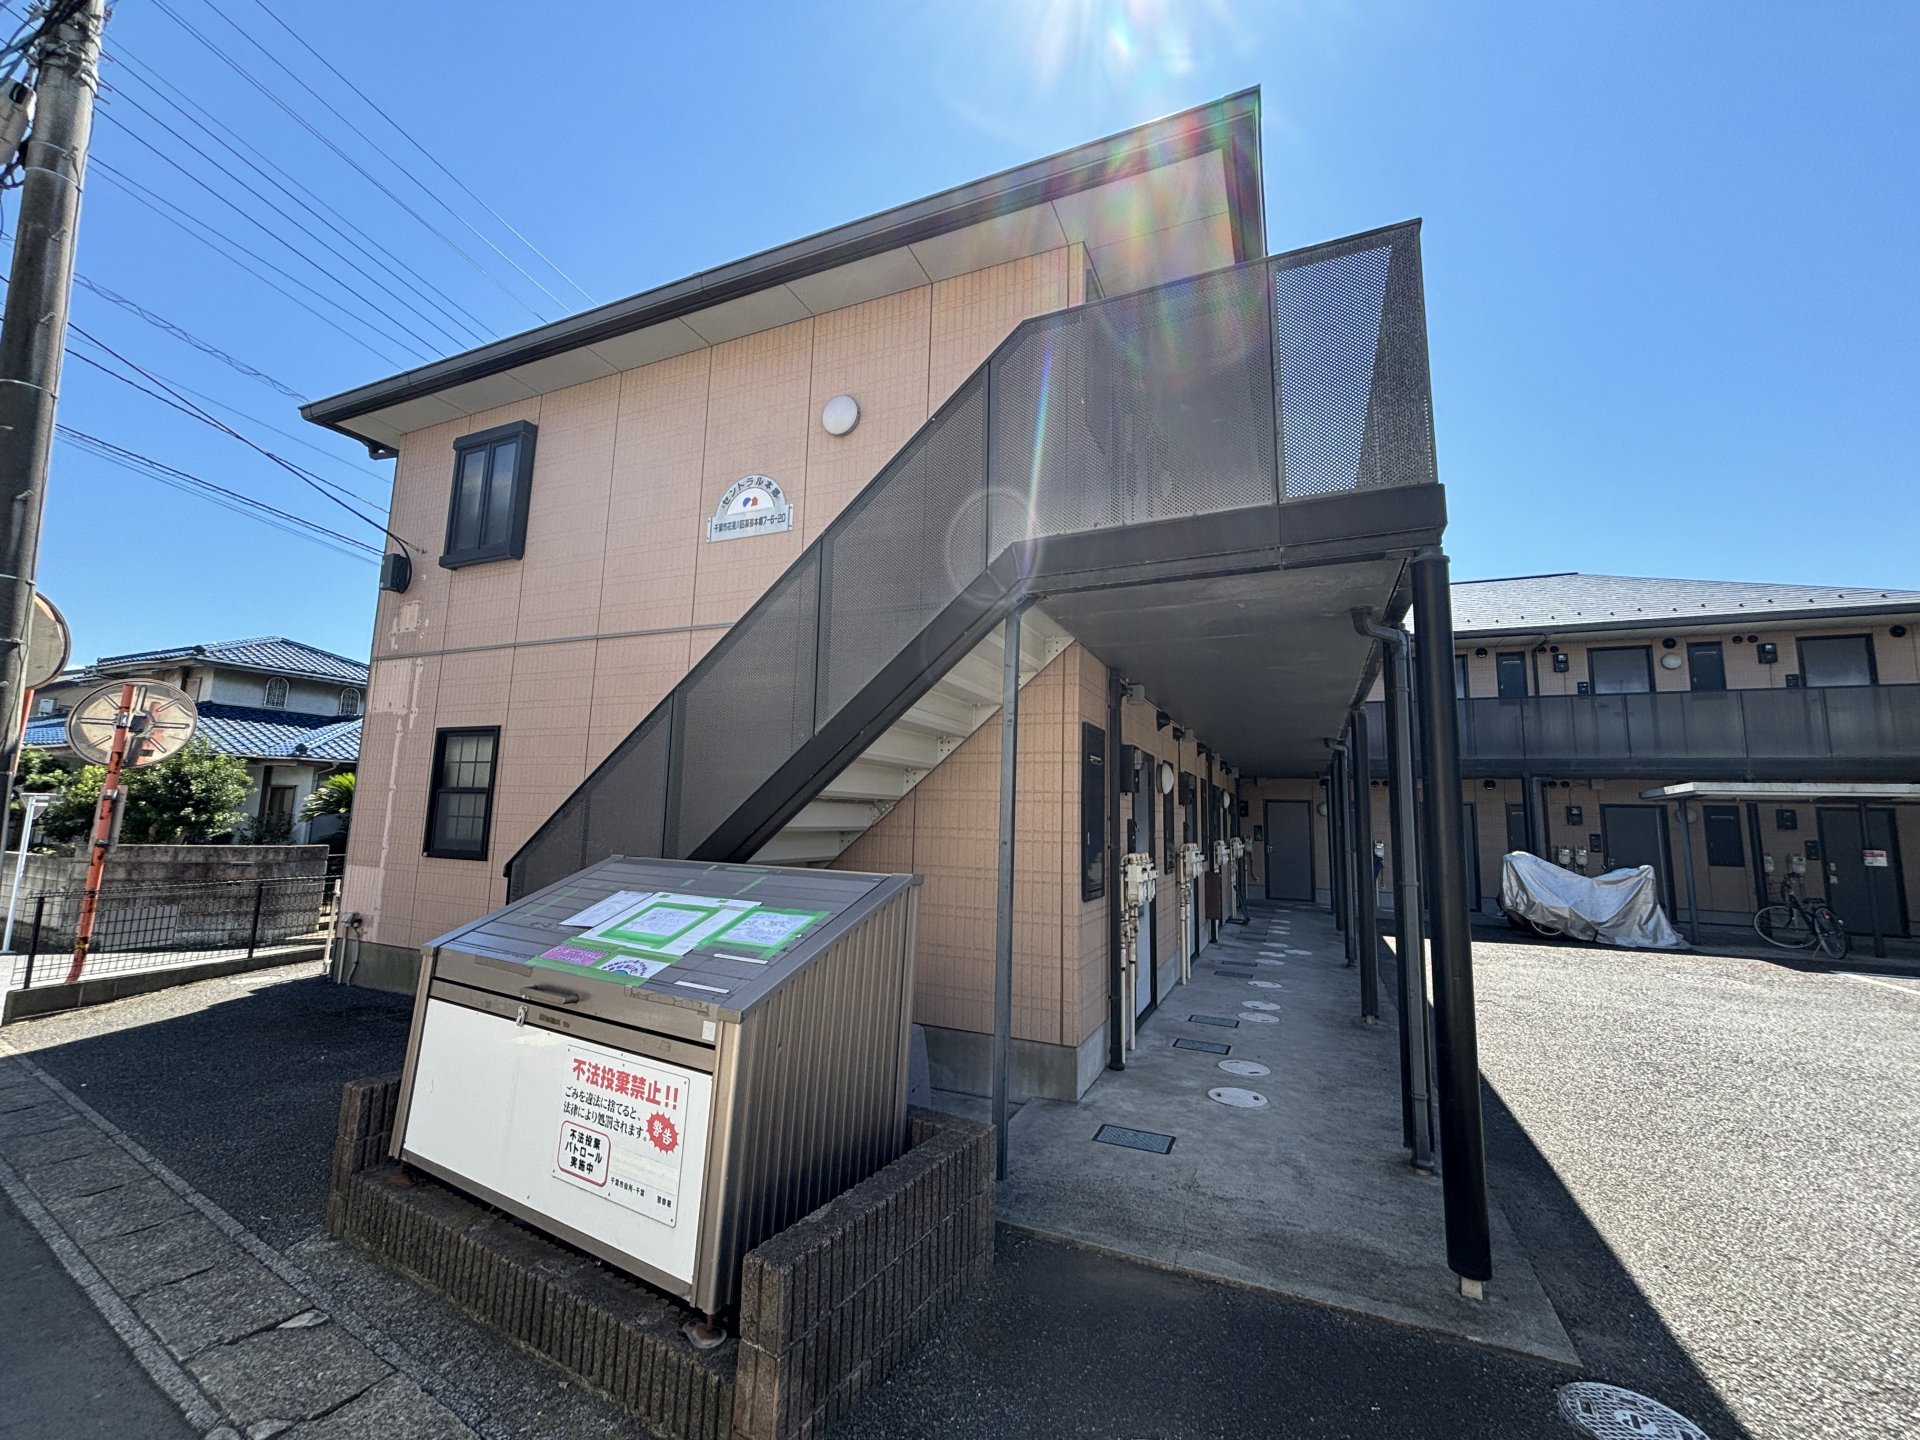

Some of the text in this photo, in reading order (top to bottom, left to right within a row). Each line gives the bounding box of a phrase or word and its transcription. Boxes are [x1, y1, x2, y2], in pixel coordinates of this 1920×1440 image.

[572, 1058, 679, 1110] 不法投棄禁止!!
[565, 1086, 641, 1121] ごみを違法に捨てると、
[563, 1100, 647, 1141] 法律により処罰されます。
[652, 1120, 673, 1145] 警告
[570, 1128, 601, 1151] 不法投棄
[565, 1141, 602, 1164] パトロール
[570, 1156, 594, 1175] 実施中
